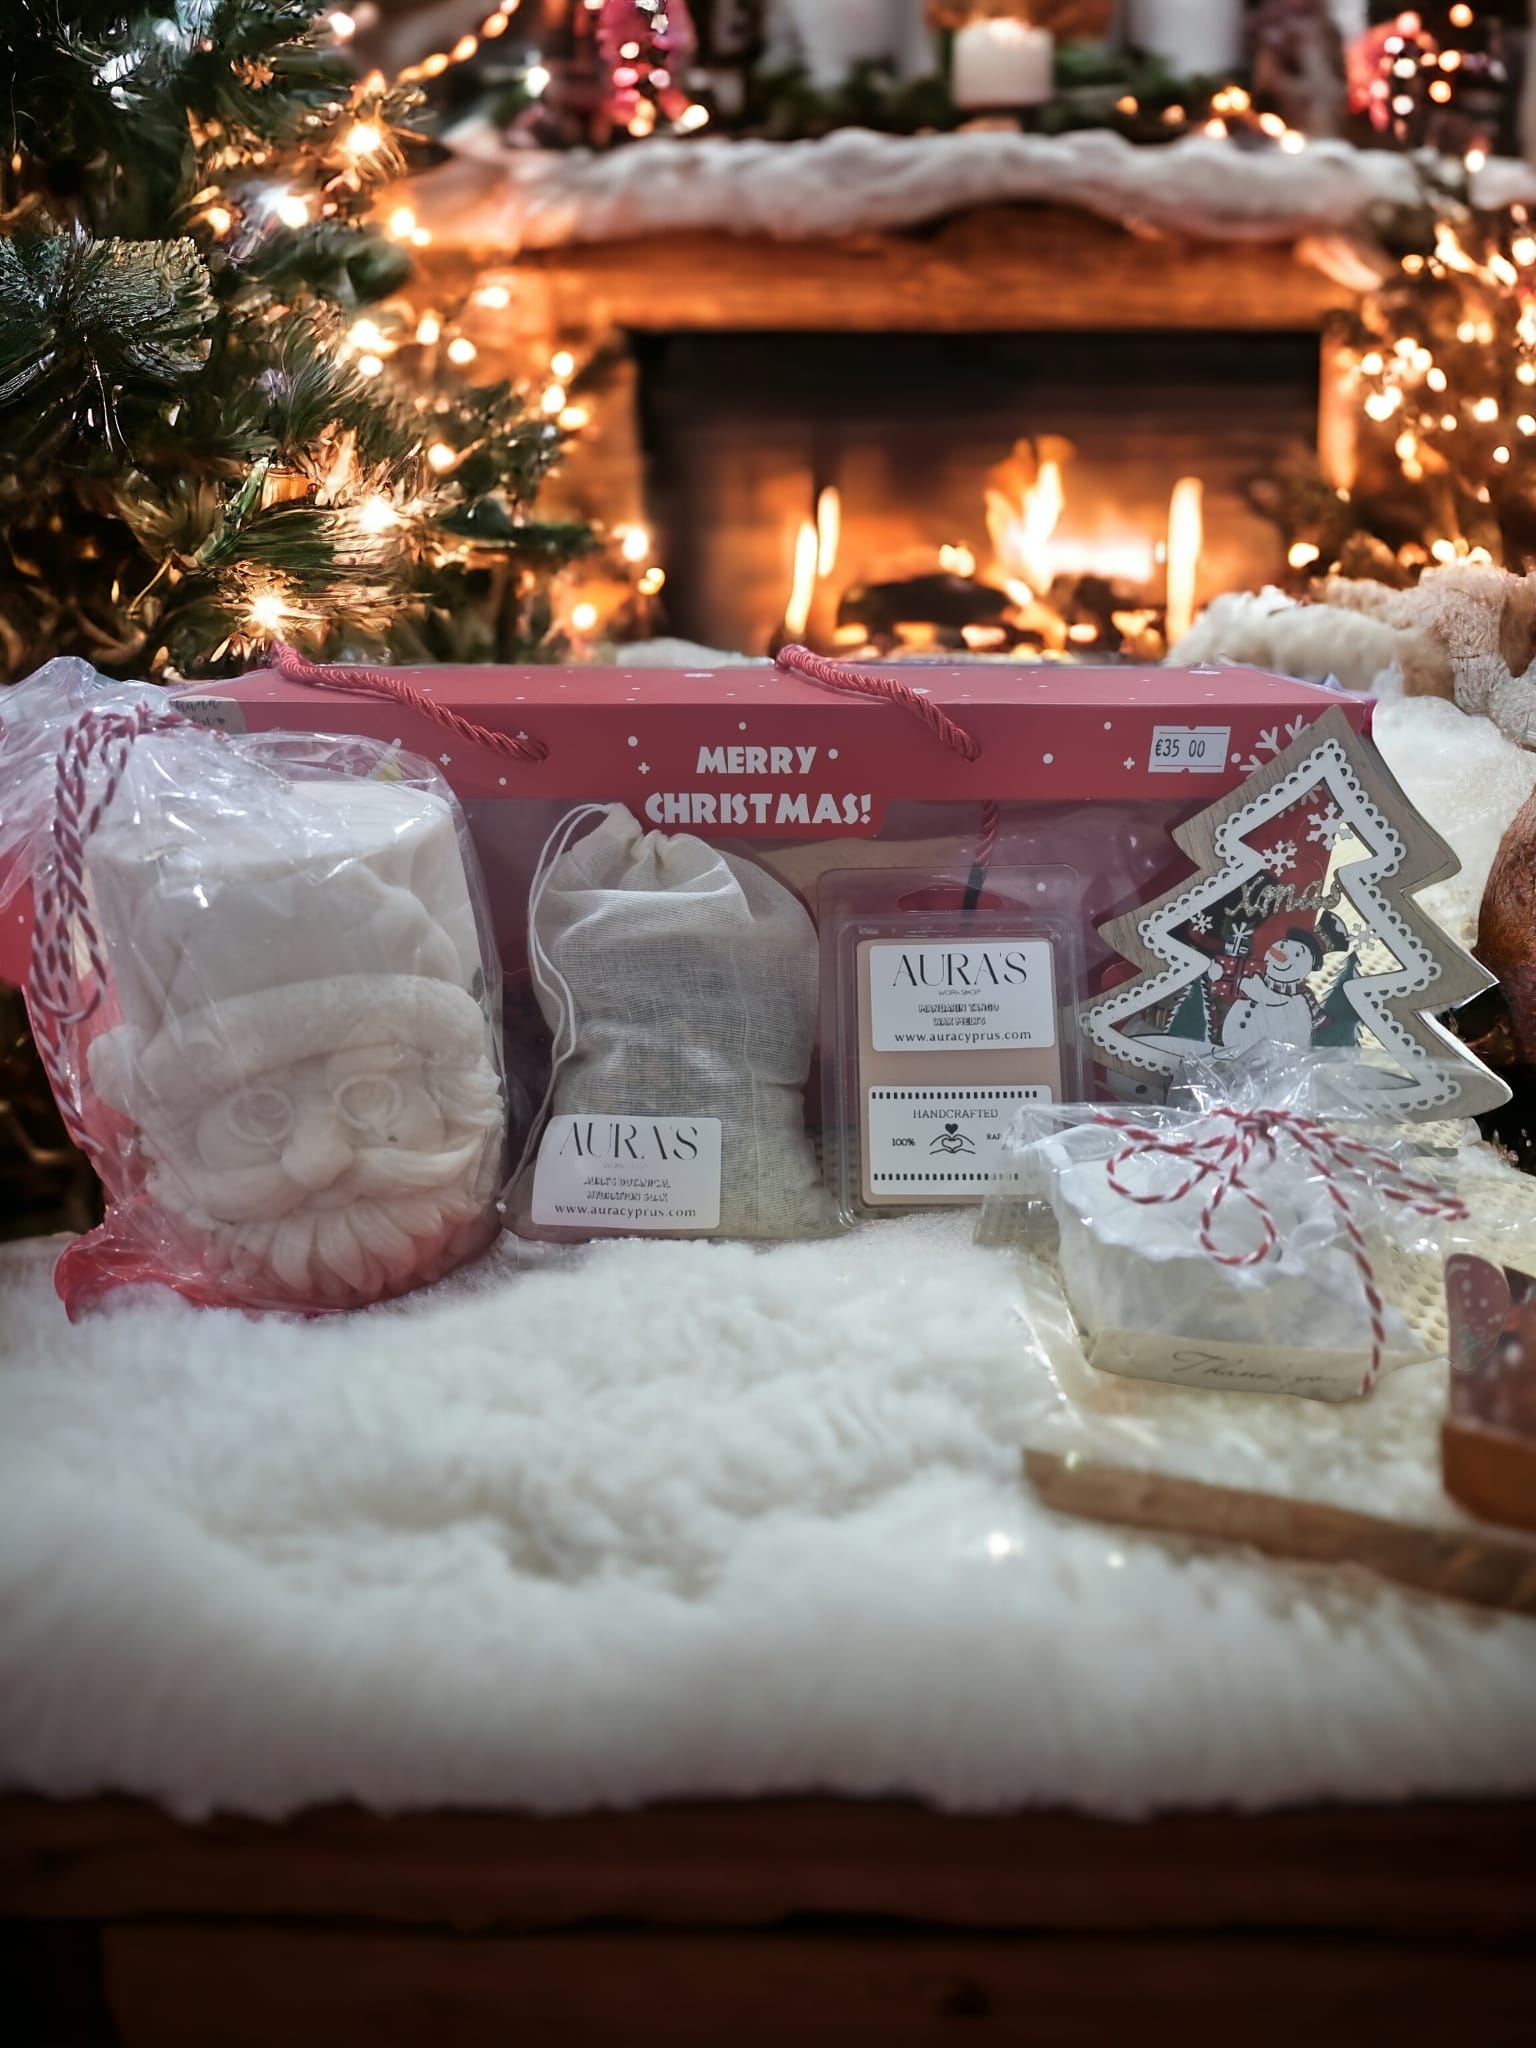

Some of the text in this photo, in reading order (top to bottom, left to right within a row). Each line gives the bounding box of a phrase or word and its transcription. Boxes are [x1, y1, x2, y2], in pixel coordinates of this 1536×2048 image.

[1155, 738, 1180, 757] €35
[696, 746, 817, 774] MERRY
[645, 792, 872, 824] CHRISTMAS!
[893, 952, 1027, 986] AURA'S
[894, 1031, 1032, 1043] www.auracyprus.com
[913, 1109, 999, 1118] HANDCRAFTED
[891, 1138, 916, 1147] 100%
[555, 1204, 696, 1219] www.auracyprus.com
